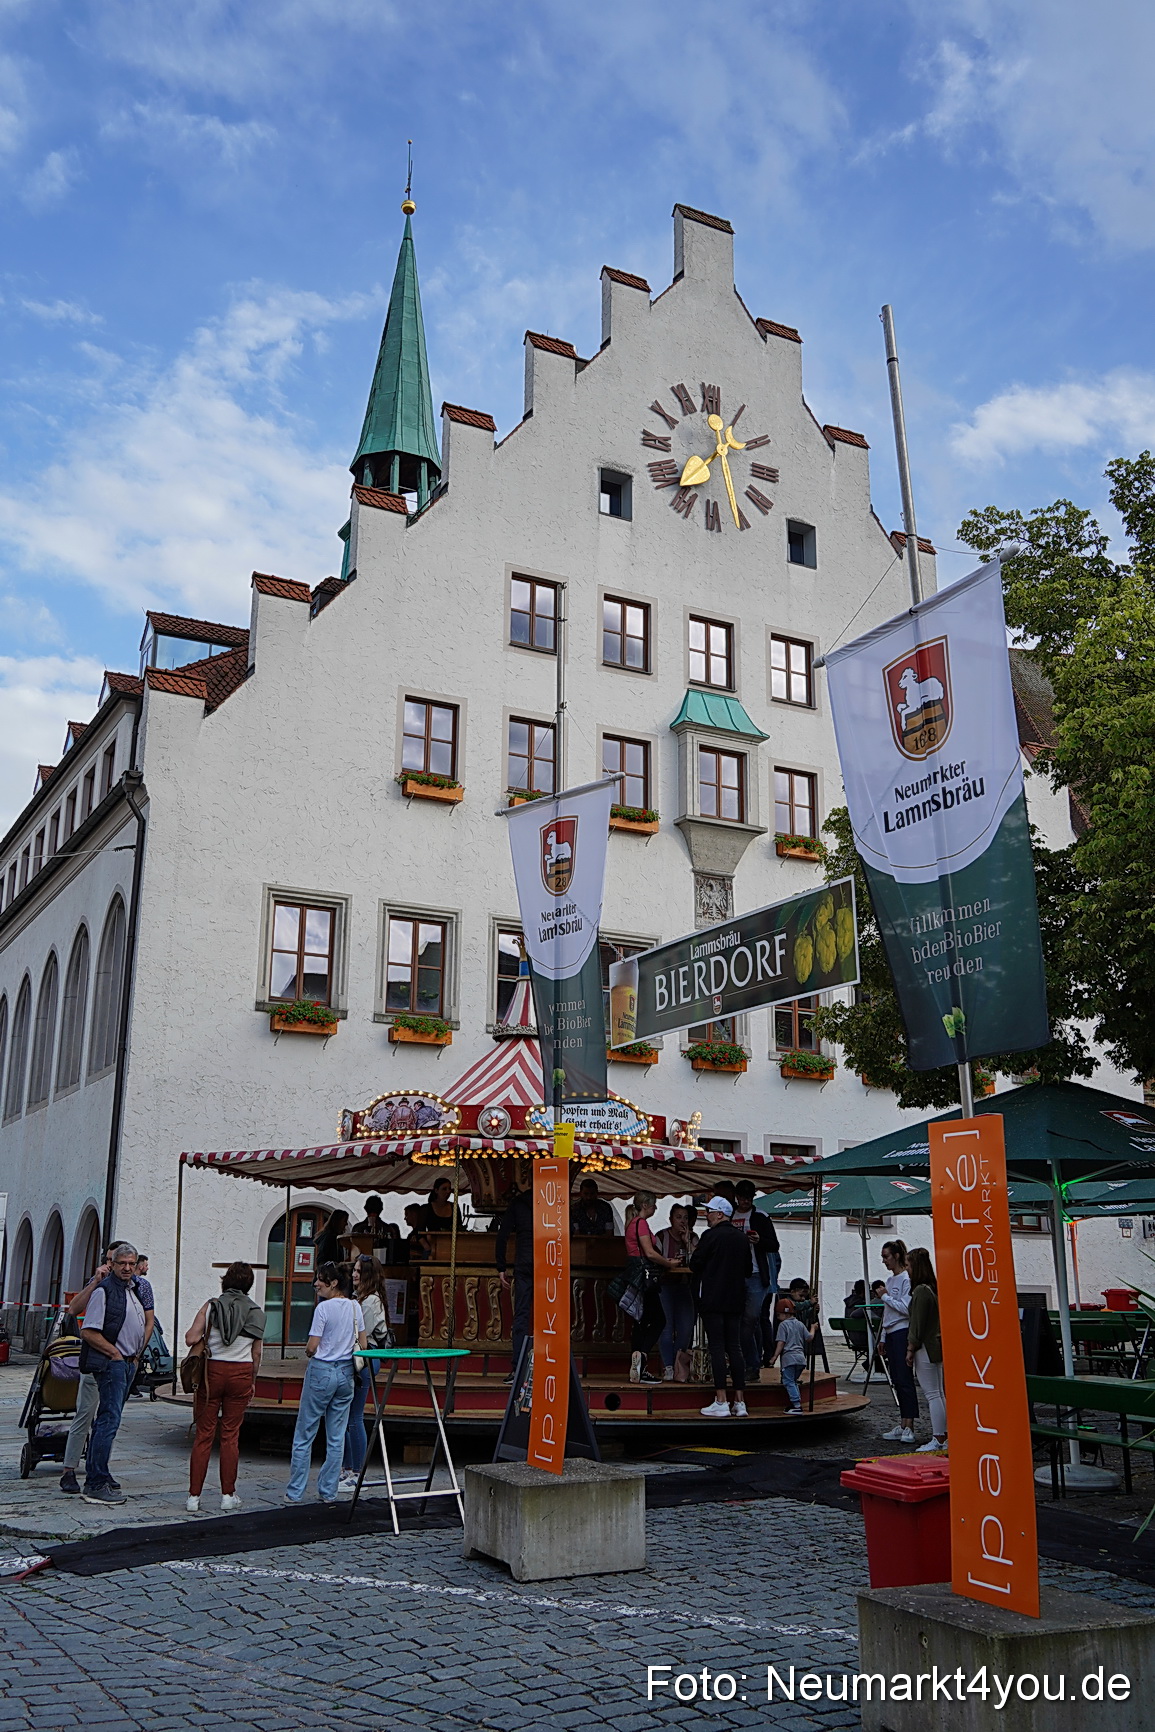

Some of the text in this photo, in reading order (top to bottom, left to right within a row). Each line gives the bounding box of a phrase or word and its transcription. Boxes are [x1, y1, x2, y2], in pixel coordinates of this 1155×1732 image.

[649, 400, 679, 430] X
[751, 462, 779, 482] III
[689, 930, 741, 961] Lammsbräu
[654, 932, 787, 1012] BIERDORF
[591, 1107, 606, 1118] und
[608, 1107, 629, 1120] Malz
[978, 1153, 1001, 1304] NEUMARKT
